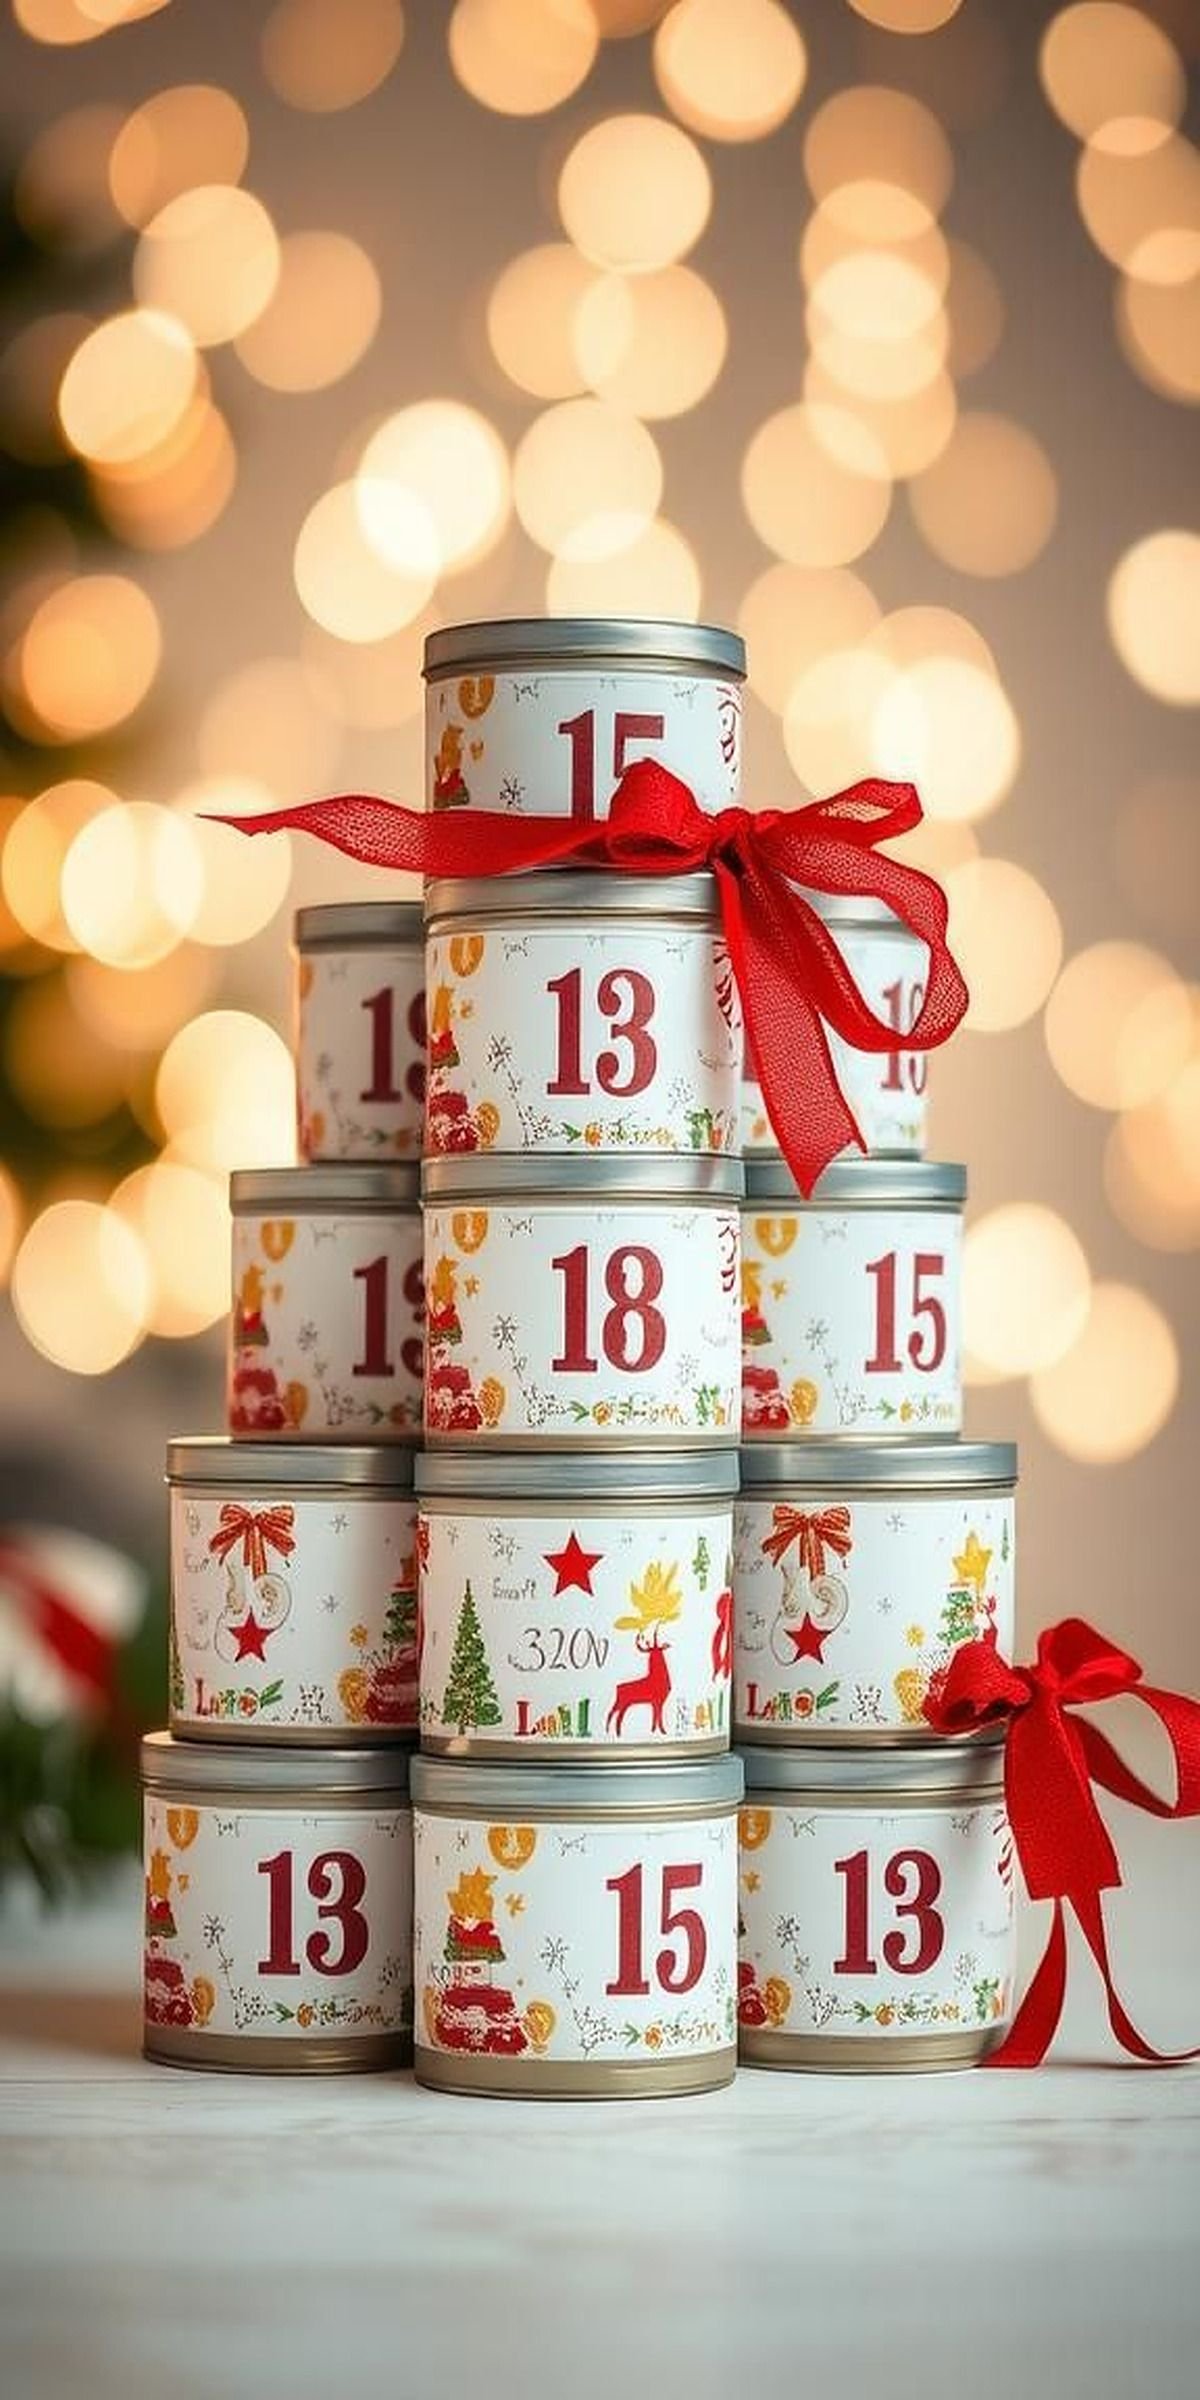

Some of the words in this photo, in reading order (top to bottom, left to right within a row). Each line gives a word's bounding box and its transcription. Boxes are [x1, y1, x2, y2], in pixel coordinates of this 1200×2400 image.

[547, 967, 657, 1097] 13
[552, 1244, 666, 1373] 18
[866, 1251, 946, 1373] 15
[257, 1849, 368, 1977] 13
[606, 1863, 706, 1997] 15
[834, 1848, 944, 1976] 13
